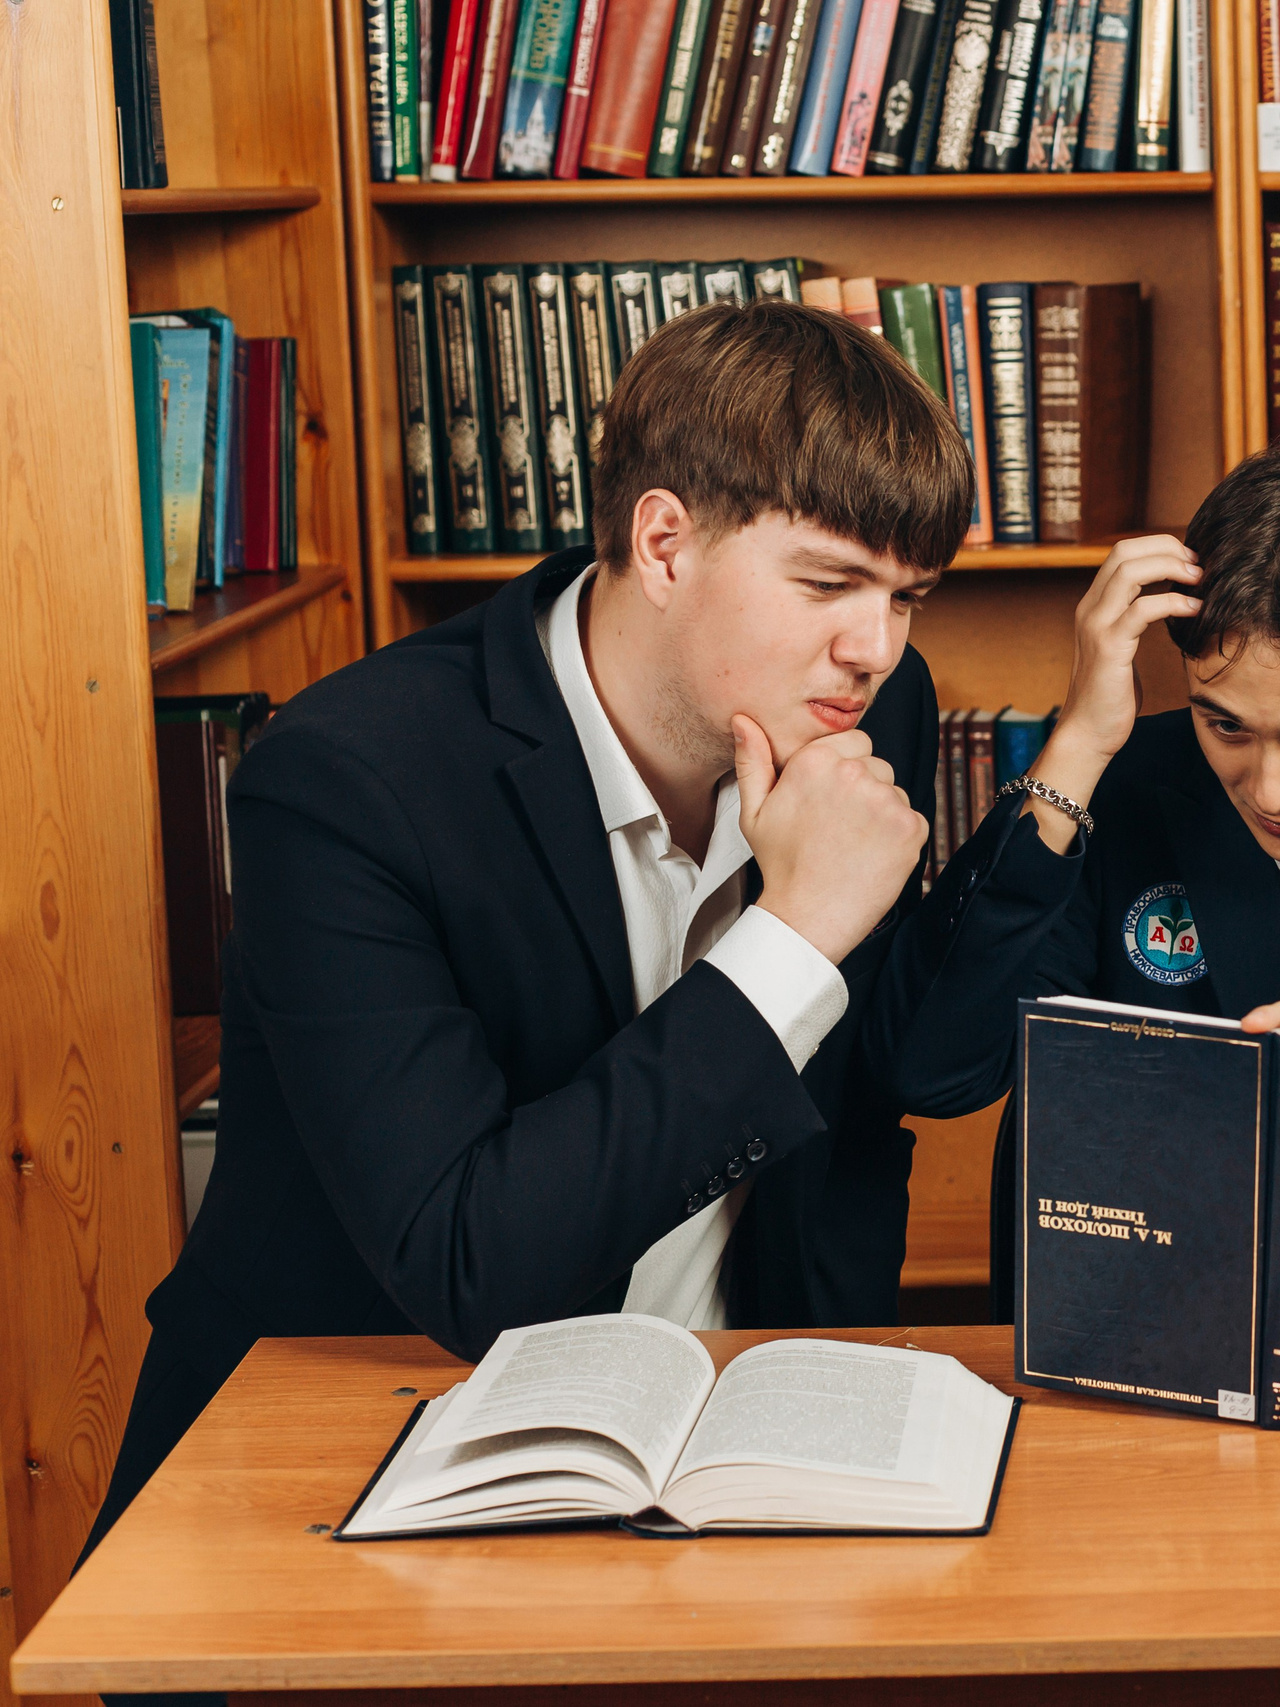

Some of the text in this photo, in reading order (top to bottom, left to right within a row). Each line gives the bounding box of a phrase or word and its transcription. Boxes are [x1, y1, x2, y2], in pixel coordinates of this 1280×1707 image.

[530, 0, 553, 69] ОРОКОВ
[1130, 948, 1208, 983] НИЖНЕВАРТОВС
[1056, 1201, 1091, 1220] Дон
[1092, 1206, 1147, 1226] Тихий
[1038, 1214, 1174, 1246] М. А. ШОЛОХОВ
[1074, 1376, 1203, 1405] ПУШКИНСКАЯ БИБЛИОТЕКА
